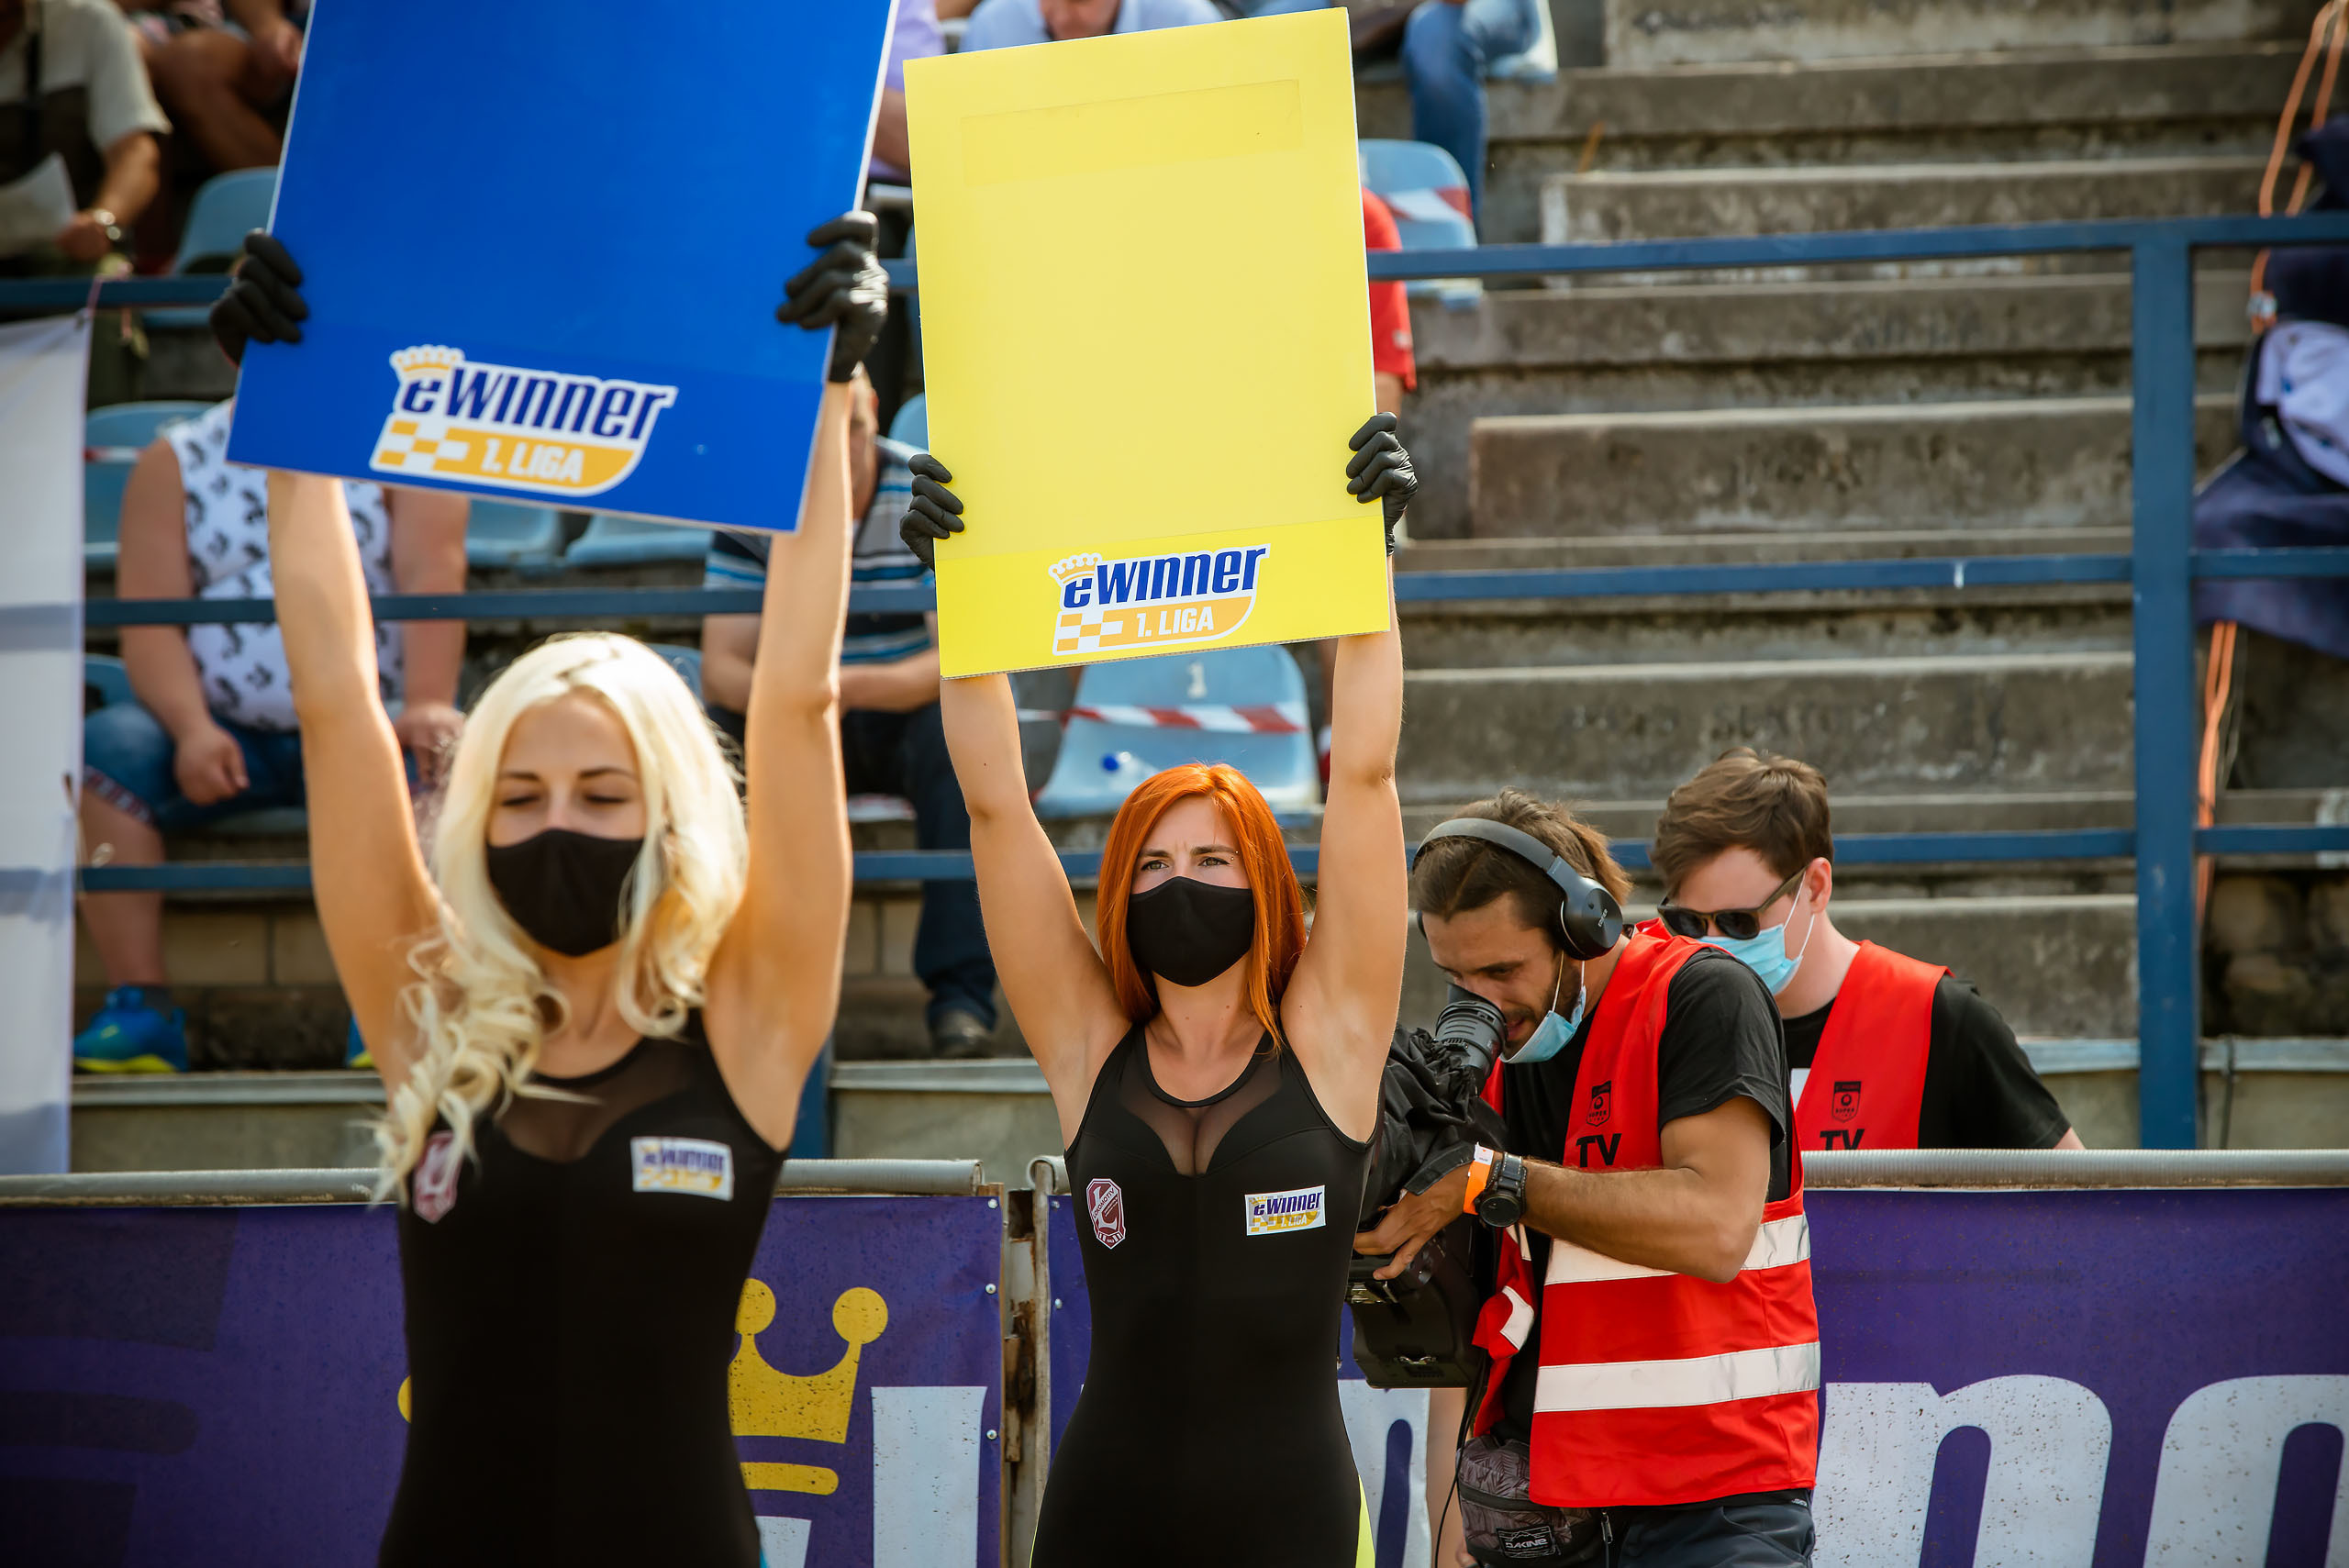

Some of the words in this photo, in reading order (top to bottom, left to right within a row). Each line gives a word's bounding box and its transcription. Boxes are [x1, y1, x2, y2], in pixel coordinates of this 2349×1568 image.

[481, 438, 503, 473] 1.
[507, 443, 585, 484] LIGA
[1136, 612, 1152, 638] 1.
[1158, 606, 1215, 636] LIGA
[1575, 1132, 1623, 1168] TV
[1819, 1128, 1865, 1151] TV
[1505, 1538, 1548, 1549] DAKINE
